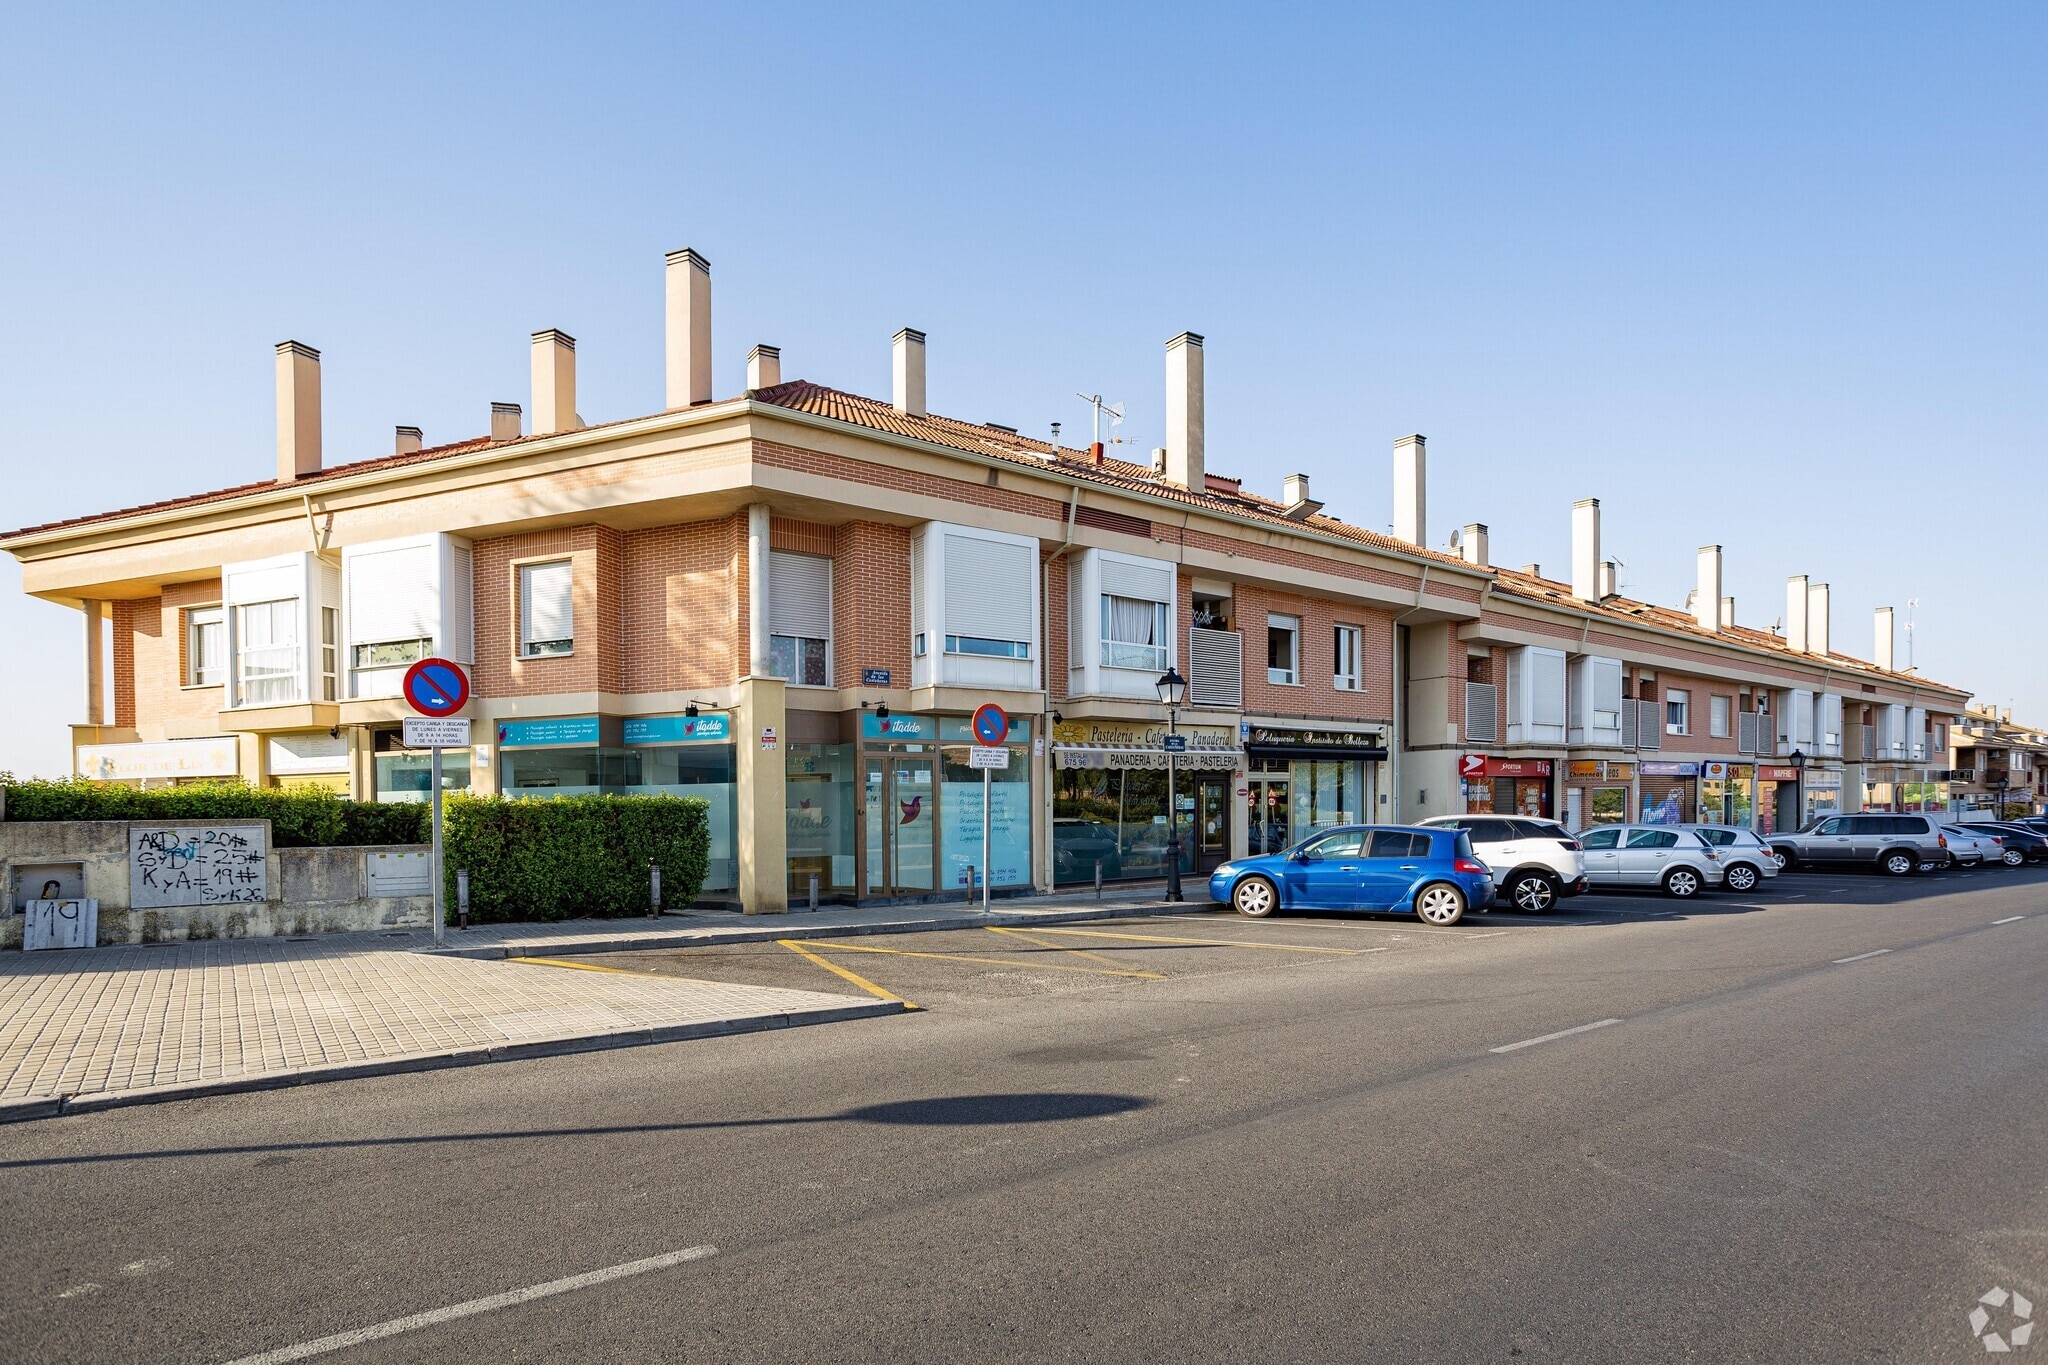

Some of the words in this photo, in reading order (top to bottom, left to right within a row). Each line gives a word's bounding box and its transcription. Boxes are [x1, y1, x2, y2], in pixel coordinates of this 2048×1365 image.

[1090, 724, 1133, 743] Pastelería
[1192, 730, 1230, 746] Panadería
[1335, 736, 1342, 744] de
[1343, 733, 1370, 746] Belleza
[1110, 754, 1151, 766] PANADERIA
[1158, 755, 1194, 766] CAFTERIA
[1200, 755, 1238, 766] PASTELERIA
[1537, 762, 1550, 776] BAR
[1773, 769, 1792, 778] MAPFRE
